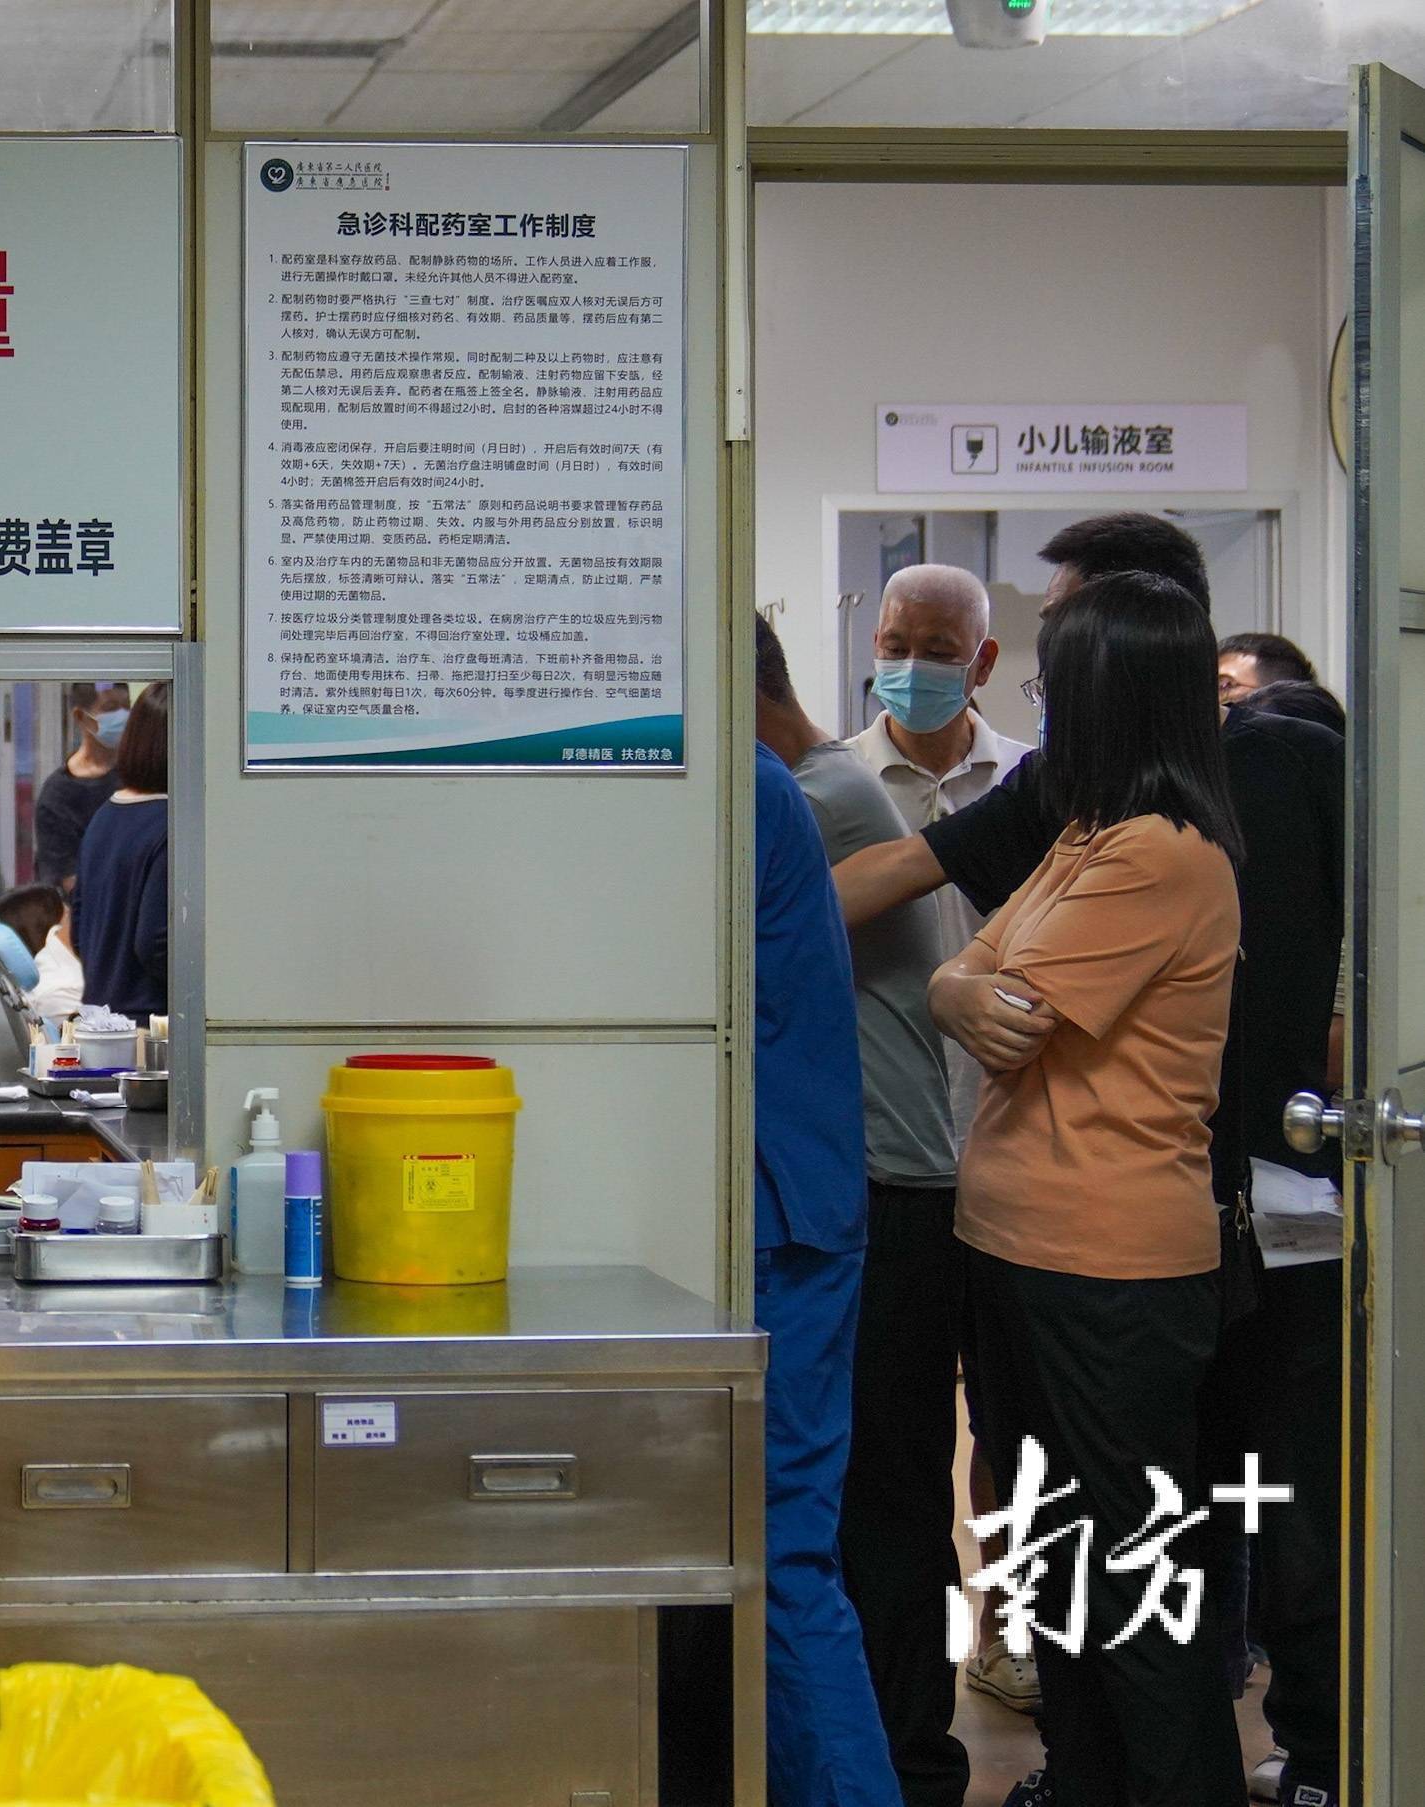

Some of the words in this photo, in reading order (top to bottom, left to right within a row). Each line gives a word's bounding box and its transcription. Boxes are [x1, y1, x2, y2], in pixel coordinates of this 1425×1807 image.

[336, 211, 597, 239] 急诊科配药室工作制度
[1017, 424, 1174, 457] 小儿输液室
[1016, 462, 1074, 474] INFANTILE
[1079, 462, 1134, 474] INFUSION
[1139, 462, 1175, 474] ROOM
[562, 748, 614, 761] 厚德精医
[621, 748, 673, 761] 扶危救急
